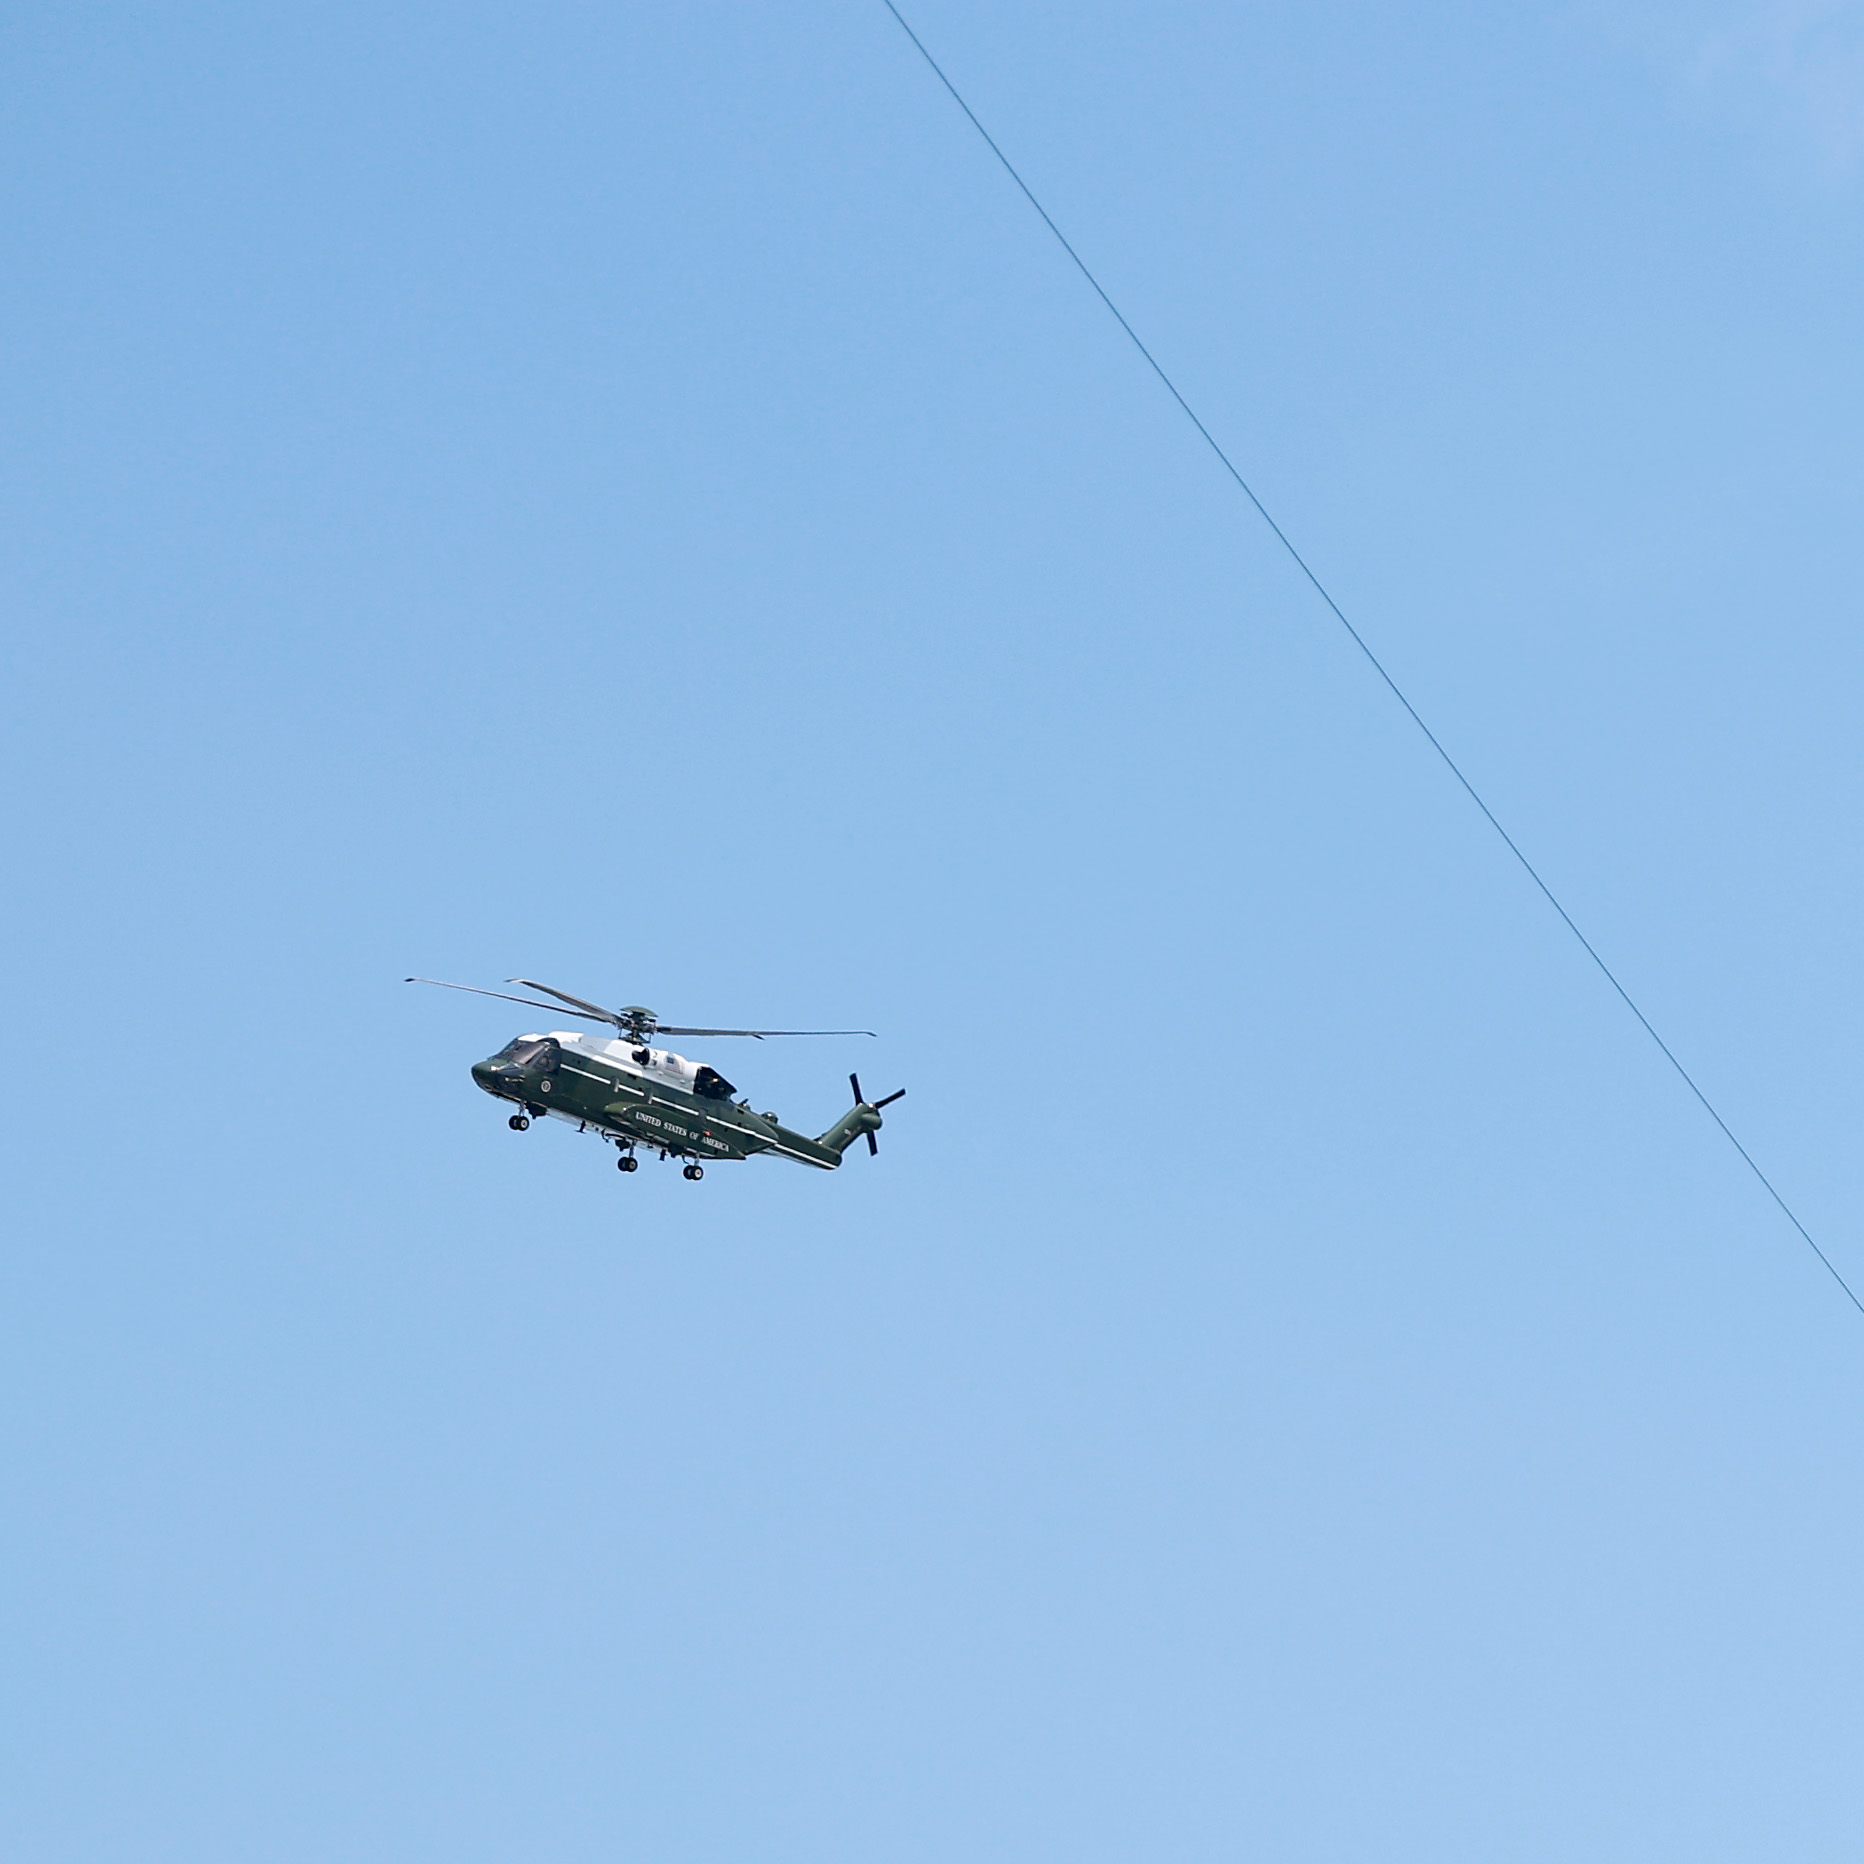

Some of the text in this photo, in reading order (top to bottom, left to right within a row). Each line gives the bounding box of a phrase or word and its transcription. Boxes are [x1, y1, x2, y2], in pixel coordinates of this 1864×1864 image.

[635, 1111, 729, 1152] UNITED STATES OF AMERICA
